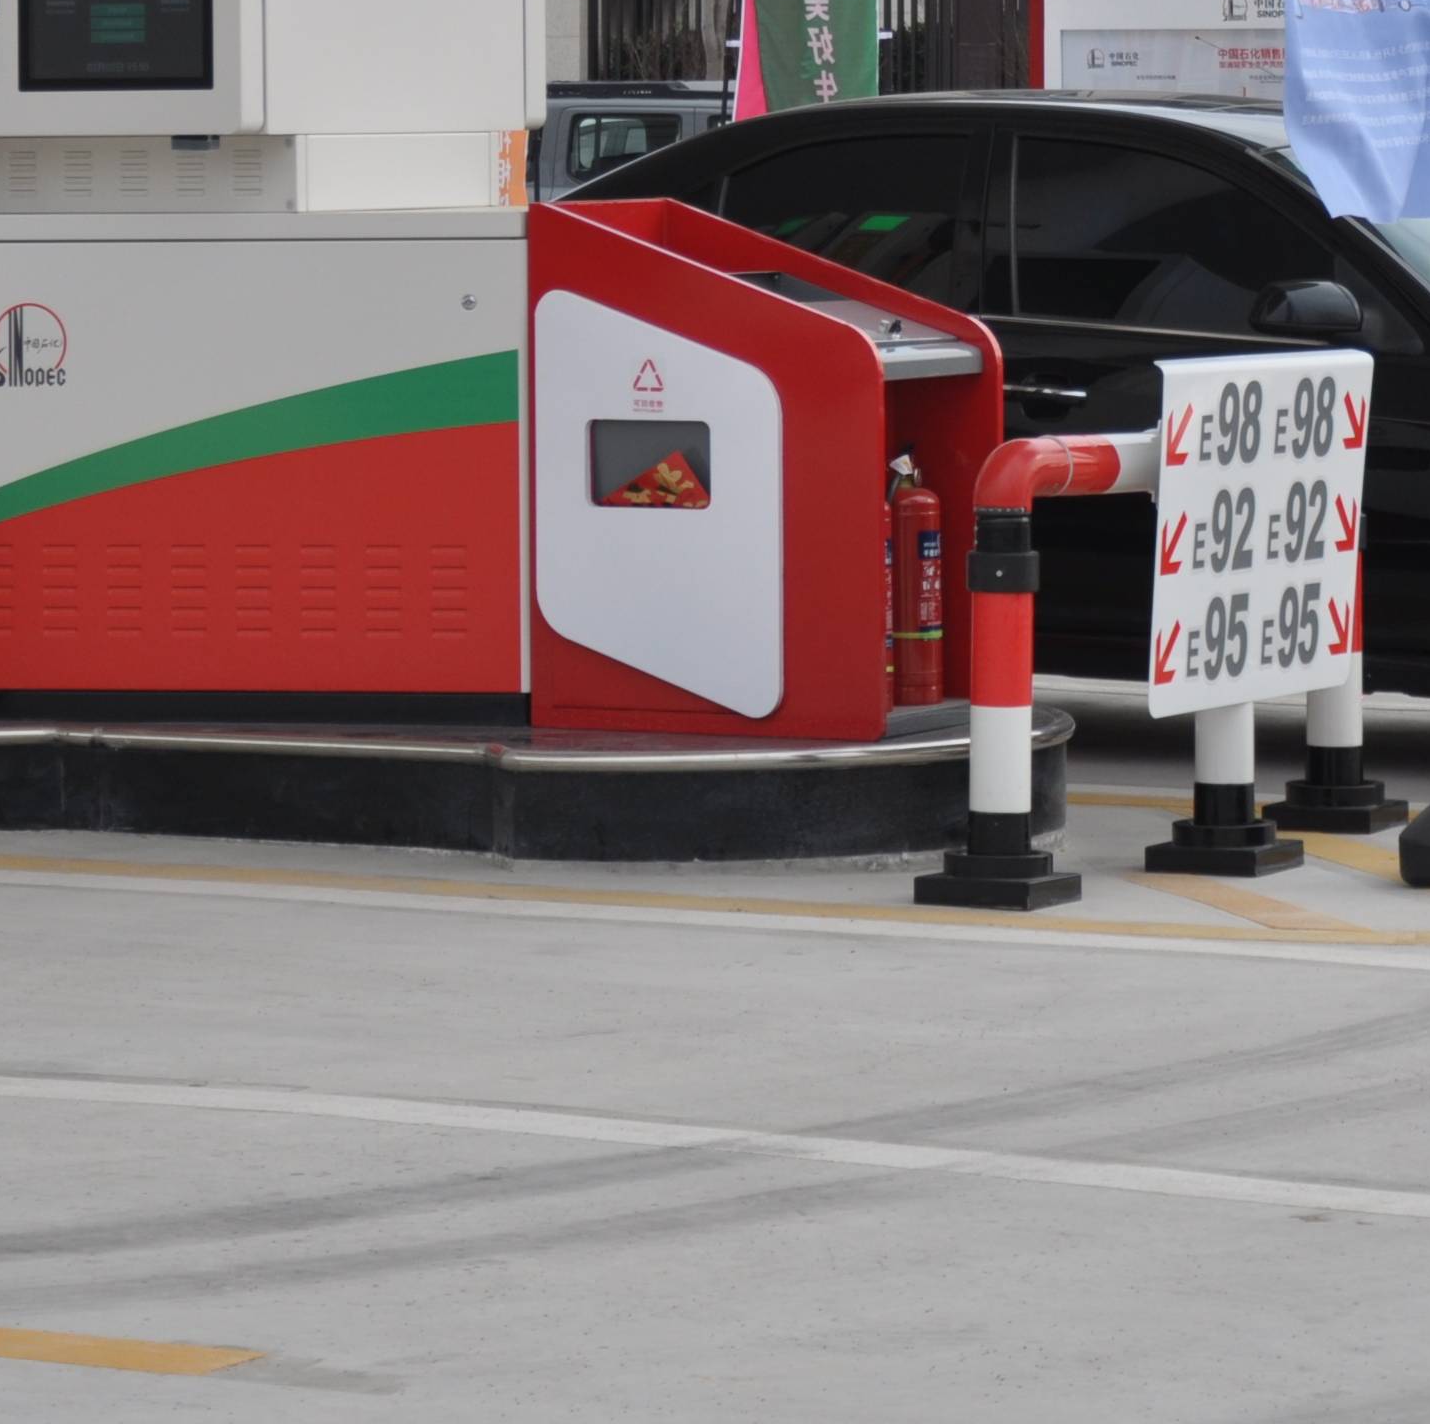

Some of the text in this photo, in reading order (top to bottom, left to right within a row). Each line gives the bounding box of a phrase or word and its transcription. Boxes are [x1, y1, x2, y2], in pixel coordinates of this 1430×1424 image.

[1109, 52, 1139, 60] 中国石化
[1218, 47, 1285, 60] 中国石化销售
[1199, 376, 1336, 465] E98 E98
[1192, 480, 1328, 573] E92 E92
[1186, 582, 1321, 680] E95 E95
